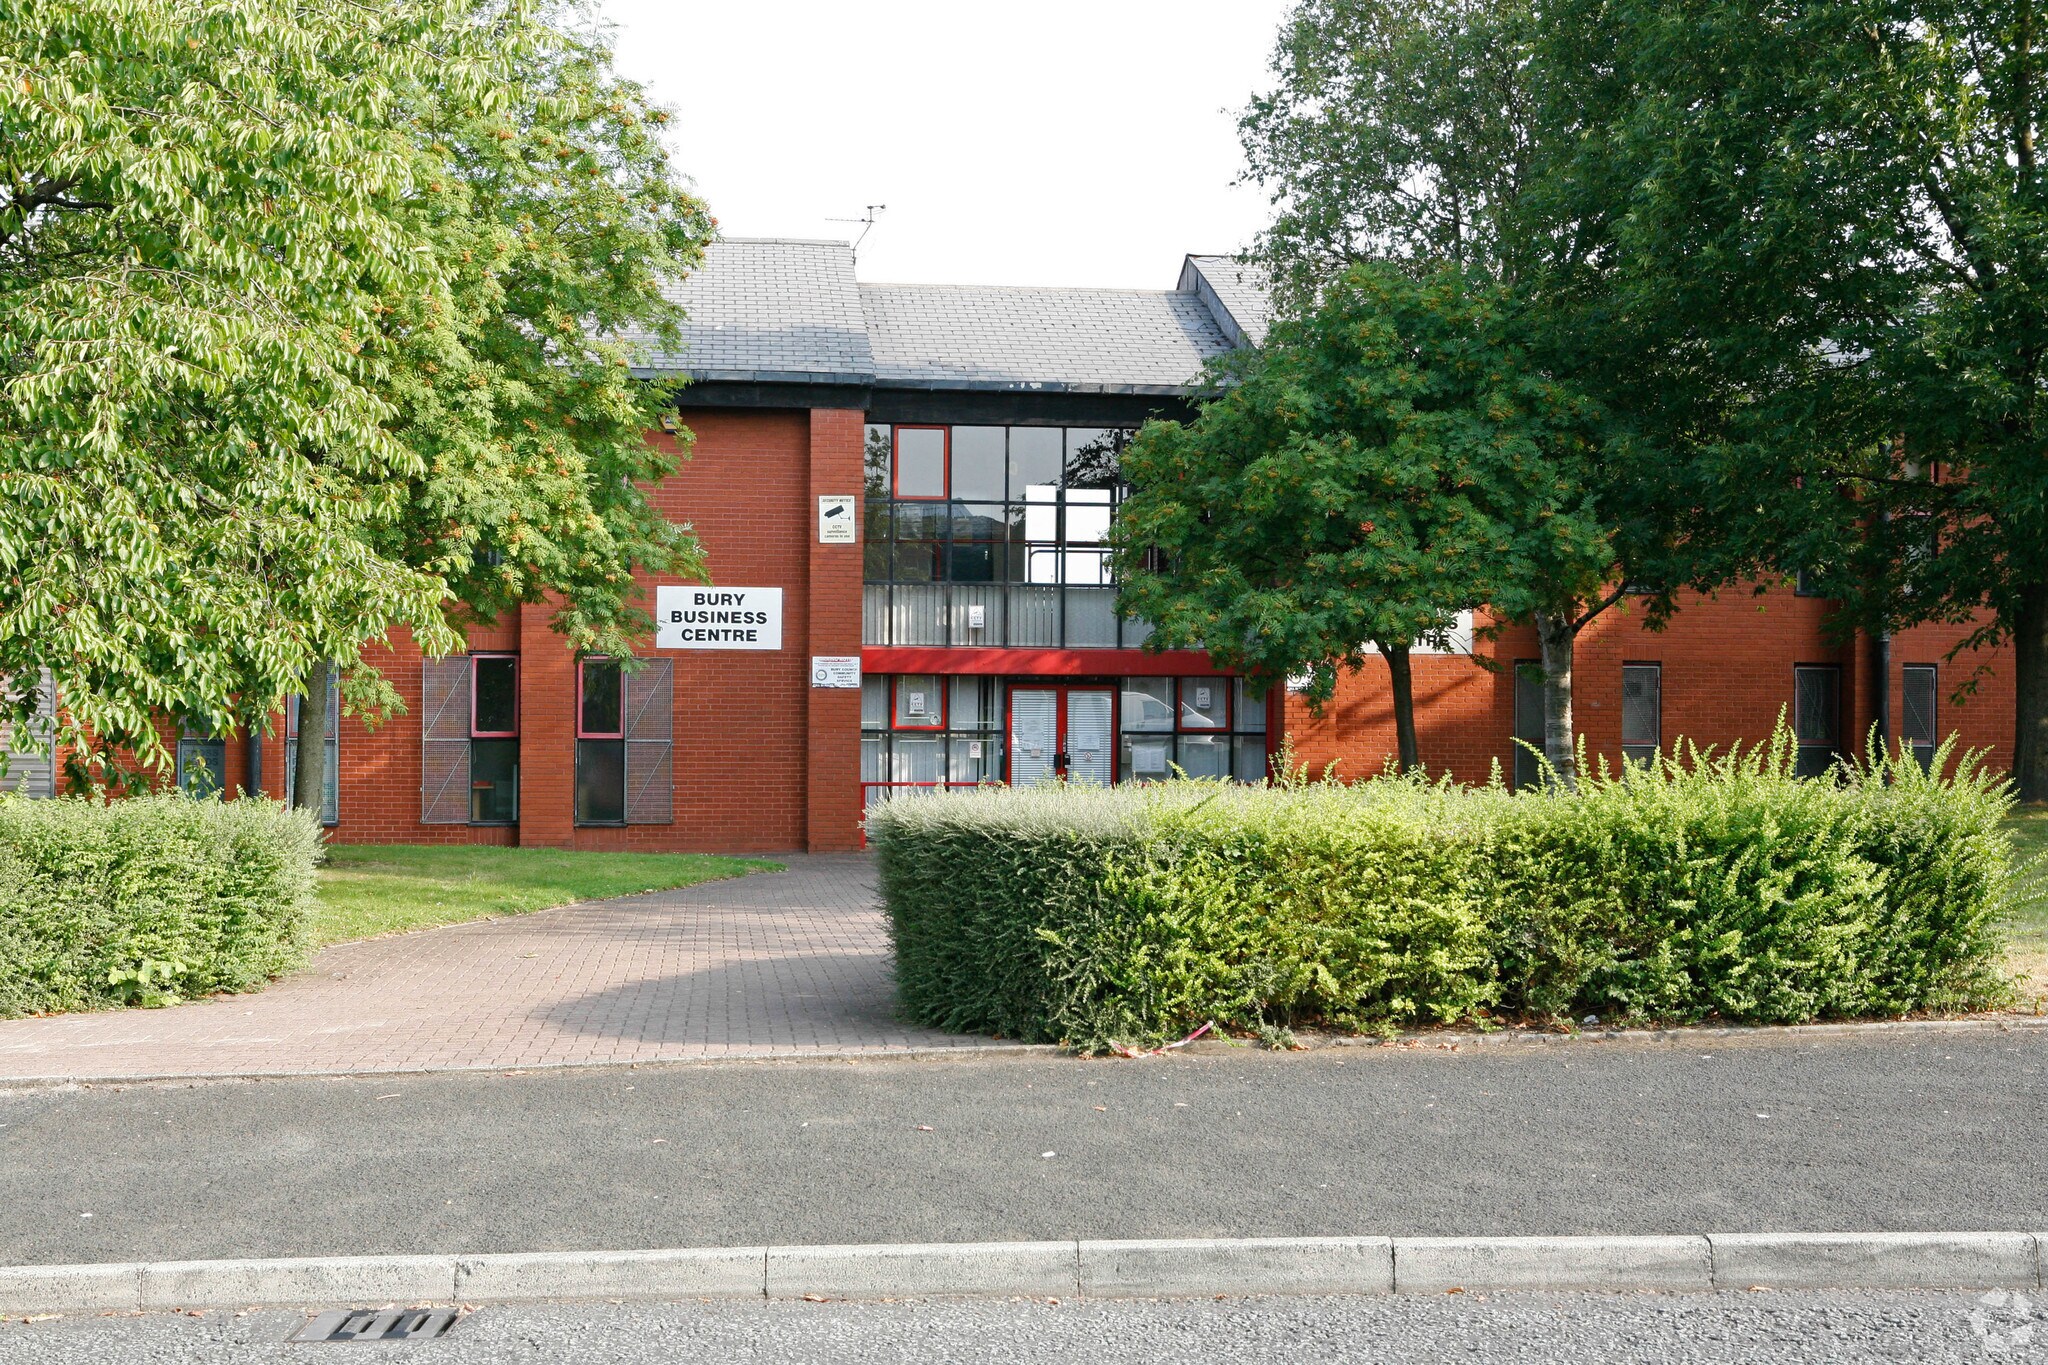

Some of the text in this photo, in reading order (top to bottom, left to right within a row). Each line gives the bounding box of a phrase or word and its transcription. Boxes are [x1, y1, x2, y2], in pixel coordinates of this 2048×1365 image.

[694, 593, 745, 606] BURY
[671, 610, 767, 624] BUSINESS
[682, 628, 758, 642] CENTRE
